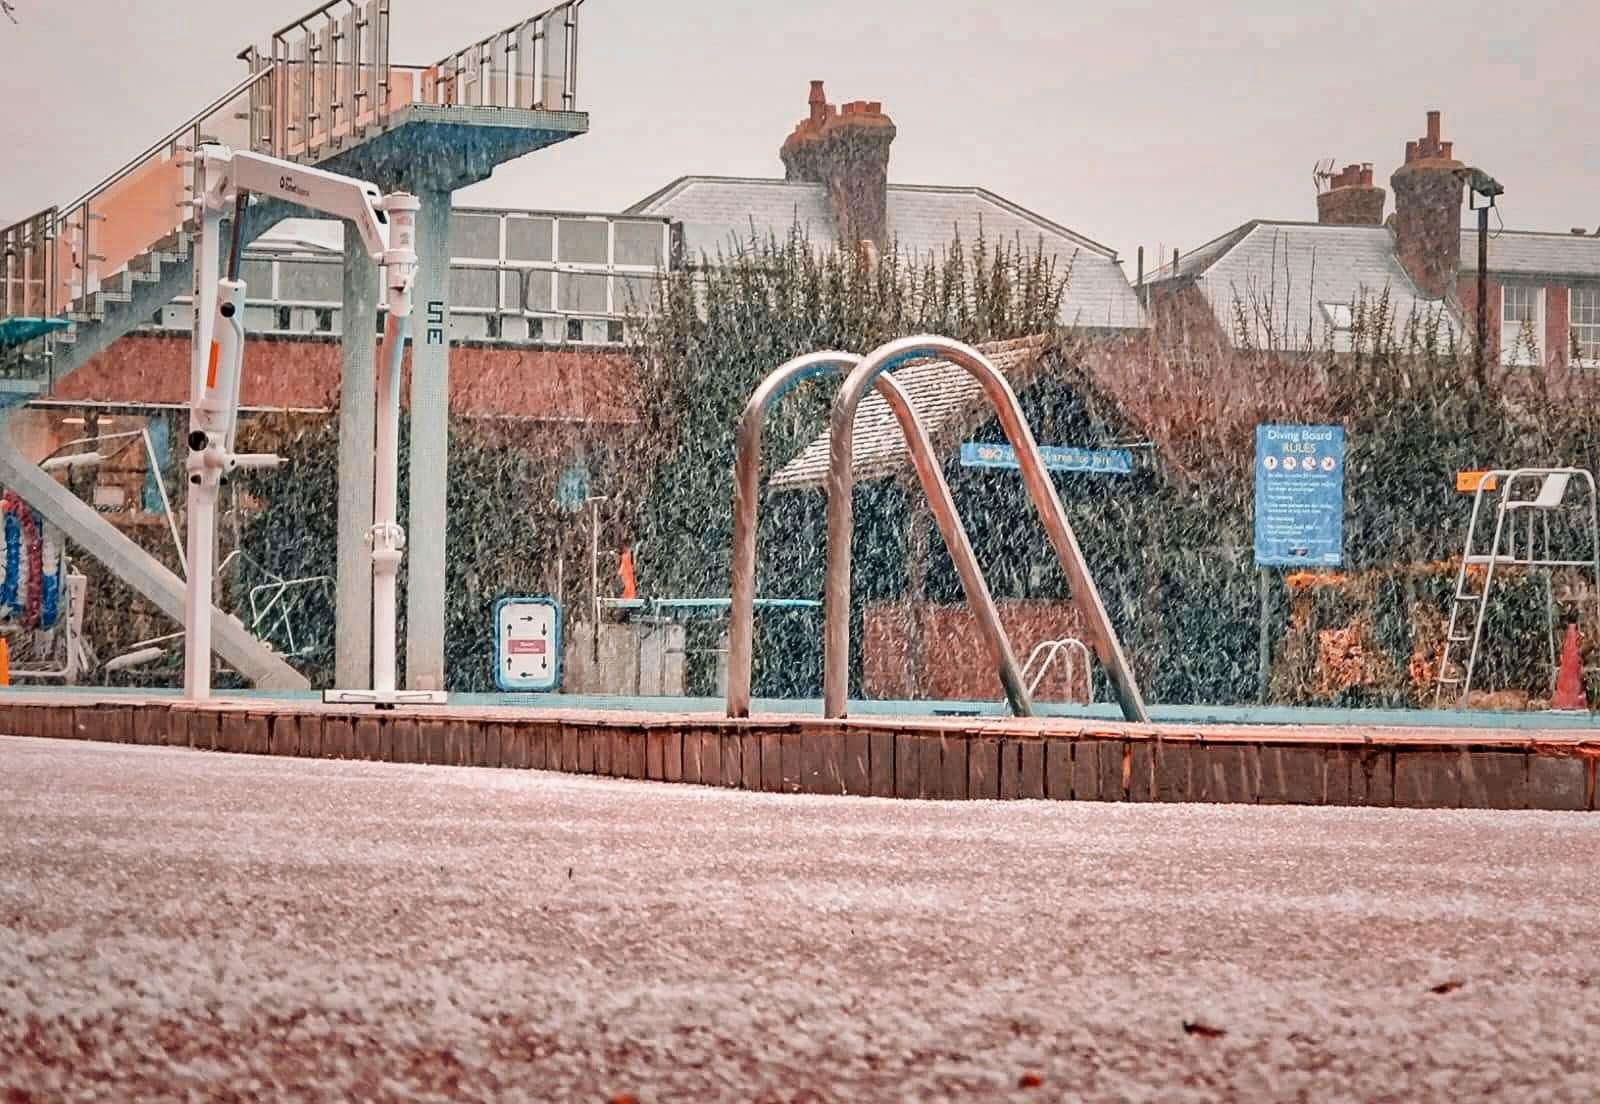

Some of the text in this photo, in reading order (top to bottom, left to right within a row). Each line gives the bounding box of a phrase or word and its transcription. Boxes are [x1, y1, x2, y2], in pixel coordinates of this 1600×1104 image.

[1267, 429, 1333, 442] Diving Board
[1282, 443, 1317, 454] RULES
